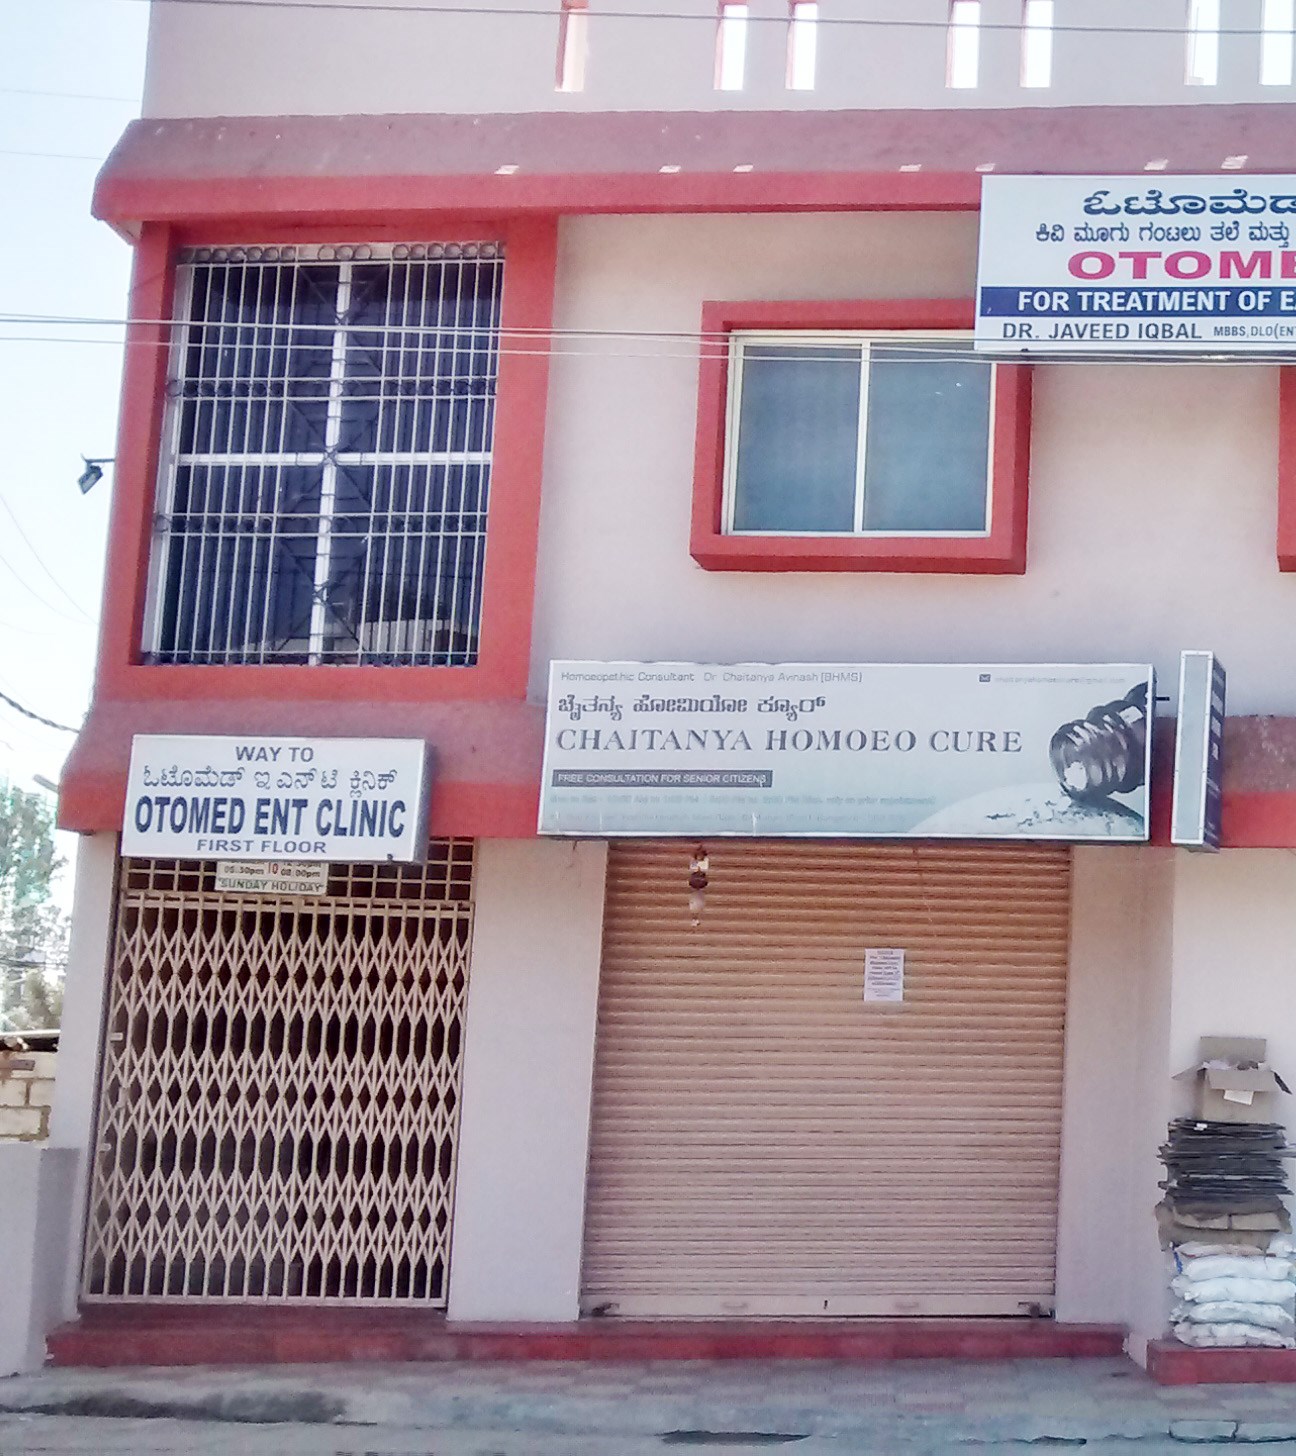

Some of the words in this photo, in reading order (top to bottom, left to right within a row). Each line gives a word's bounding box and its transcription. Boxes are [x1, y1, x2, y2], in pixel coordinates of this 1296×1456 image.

[1036, 222, 1065, 242] ಕಿವಿ
[1074, 221, 1130, 242] ಮೂಗು
[1139, 221, 1201, 242] ಗಂಟಲು
[1210, 220, 1240, 242] ತಲೆ
[1249, 220, 1290, 248] ಮತ್ತು
[1018, 291, 1070, 312] FOR
[1077, 290, 1231, 312] TREATMENT
[1238, 290, 1271, 311] OF
[1003, 322, 1040, 339] DR.
[1048, 322, 1130, 340] JAVEED
[1138, 322, 1203, 340] IQBAL
[637, 671, 695, 682] Consultant
[722, 671, 775, 683] Chaitanya
[556, 728, 752, 751] CHAITANYA
[764, 729, 917, 752] HOMOEO
[930, 730, 1024, 753] CURE
[235, 745, 282, 762] WAY
[288, 746, 314, 763] TO
[558, 773, 583, 784] FREE
[586, 773, 658, 784] CONSULTATION
[660, 773, 681, 784] FOR
[683, 773, 720, 784] SENIOR
[135, 794, 246, 835] OTOMED
[253, 797, 309, 837] ENT
[316, 798, 407, 839] CLINIC
[196, 839, 255, 852] FIRST
[260, 840, 328, 854] FLOOR
[218, 878, 268, 891] SUNDAY
